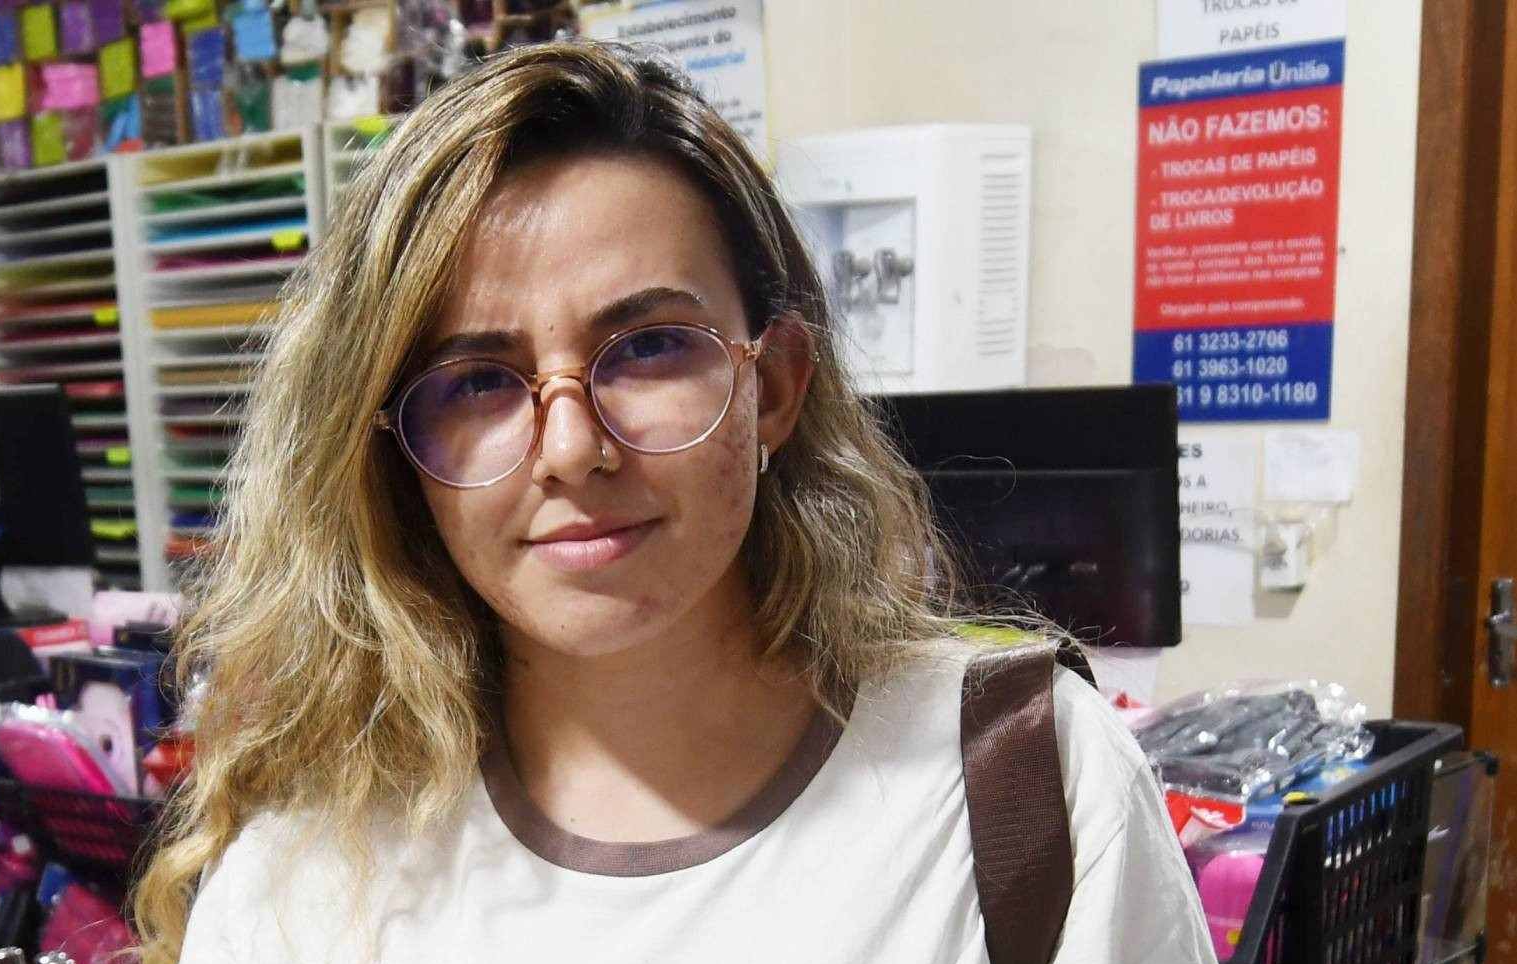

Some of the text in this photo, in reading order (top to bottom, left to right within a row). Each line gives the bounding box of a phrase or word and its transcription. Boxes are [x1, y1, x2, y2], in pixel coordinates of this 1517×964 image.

[1150, 65, 1266, 98] Papelaria
[1148, 103, 1329, 146] NÃO FAZEMOS:
[1161, 156, 1226, 178] TROCAS
[1231, 154, 1253, 171] DE
[1258, 145, 1316, 169] PAPÉIS
[1160, 176, 1324, 208] TROCA/DEVOLUÇÃO
[1150, 207, 1234, 230] DE LIVROS
[1172, 329, 1290, 352] 61 3233-2706
[1172, 356, 1288, 378] 61 3963-1020
[1199, 384, 1212, 405] 9
[1217, 381, 1318, 405] 8310-1180
